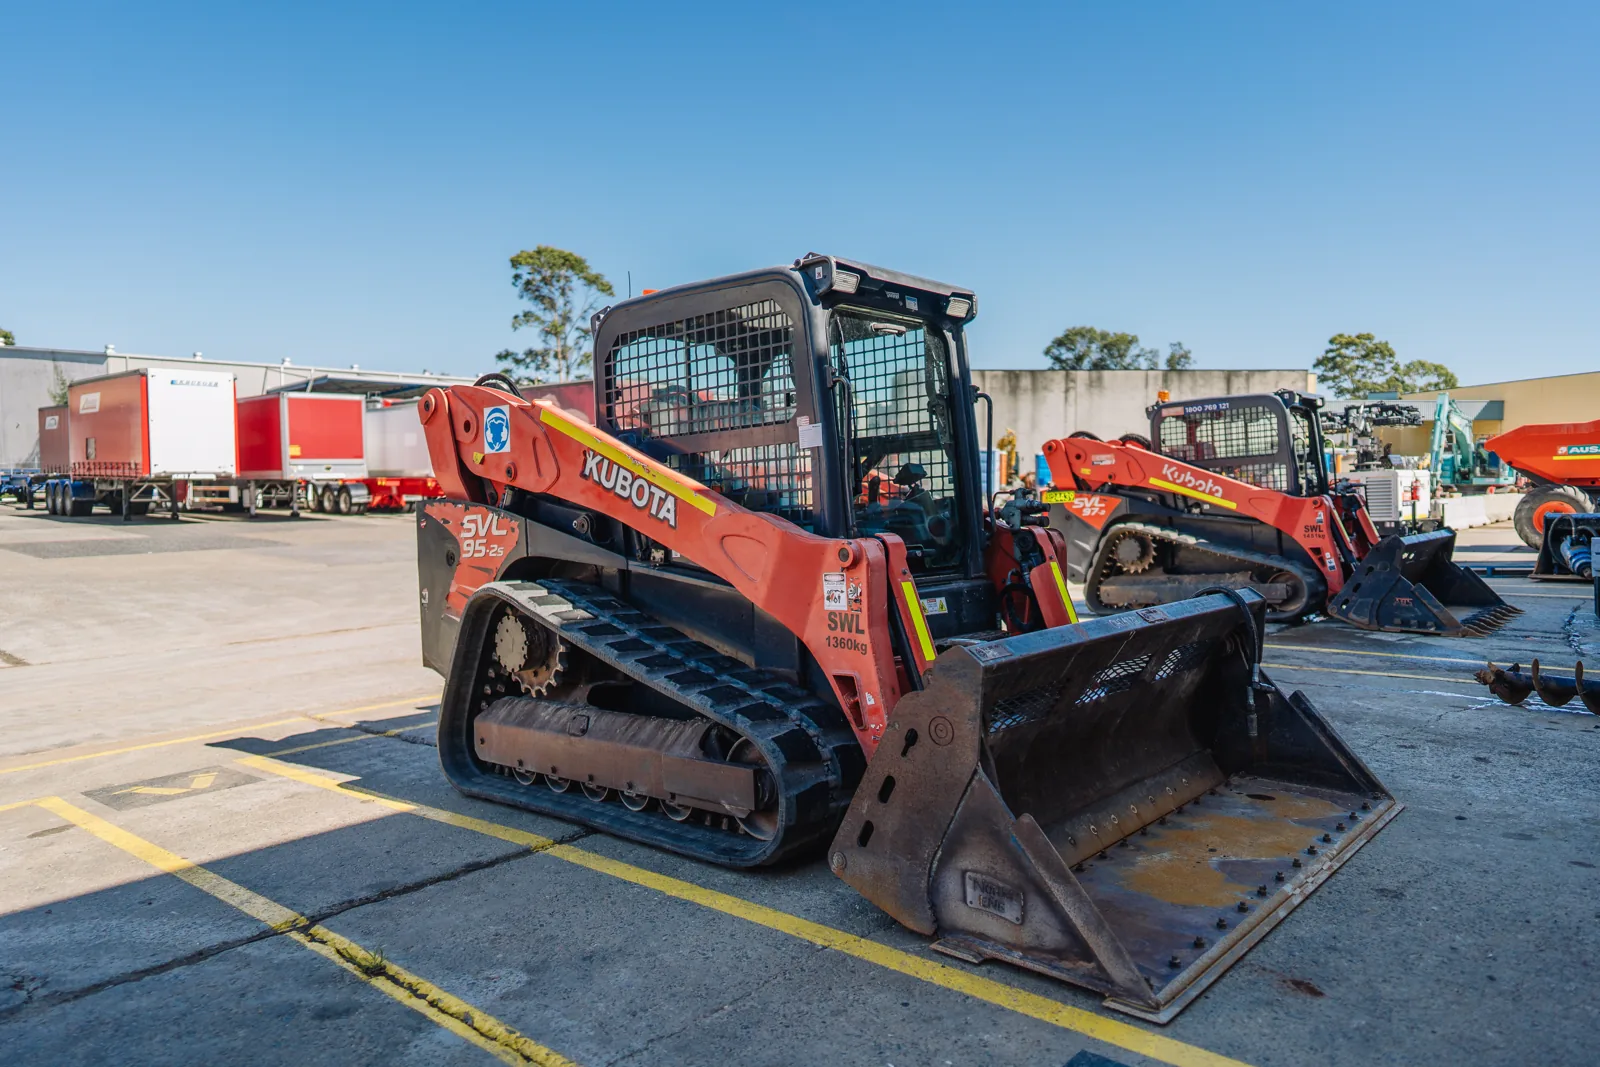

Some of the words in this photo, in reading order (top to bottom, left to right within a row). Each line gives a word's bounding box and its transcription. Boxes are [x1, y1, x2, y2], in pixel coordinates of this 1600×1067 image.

[1568, 445, 1600, 454] AUS
[582, 450, 677, 529] KUBOTA
[1162, 463, 1223, 498] Kubota
[1072, 496, 1106, 509] SVL
[460, 512, 508, 538] SVL
[1304, 524, 1324, 533] SWL
[827, 611, 865, 635] SWL
[825, 635, 868, 656] 1360kg
